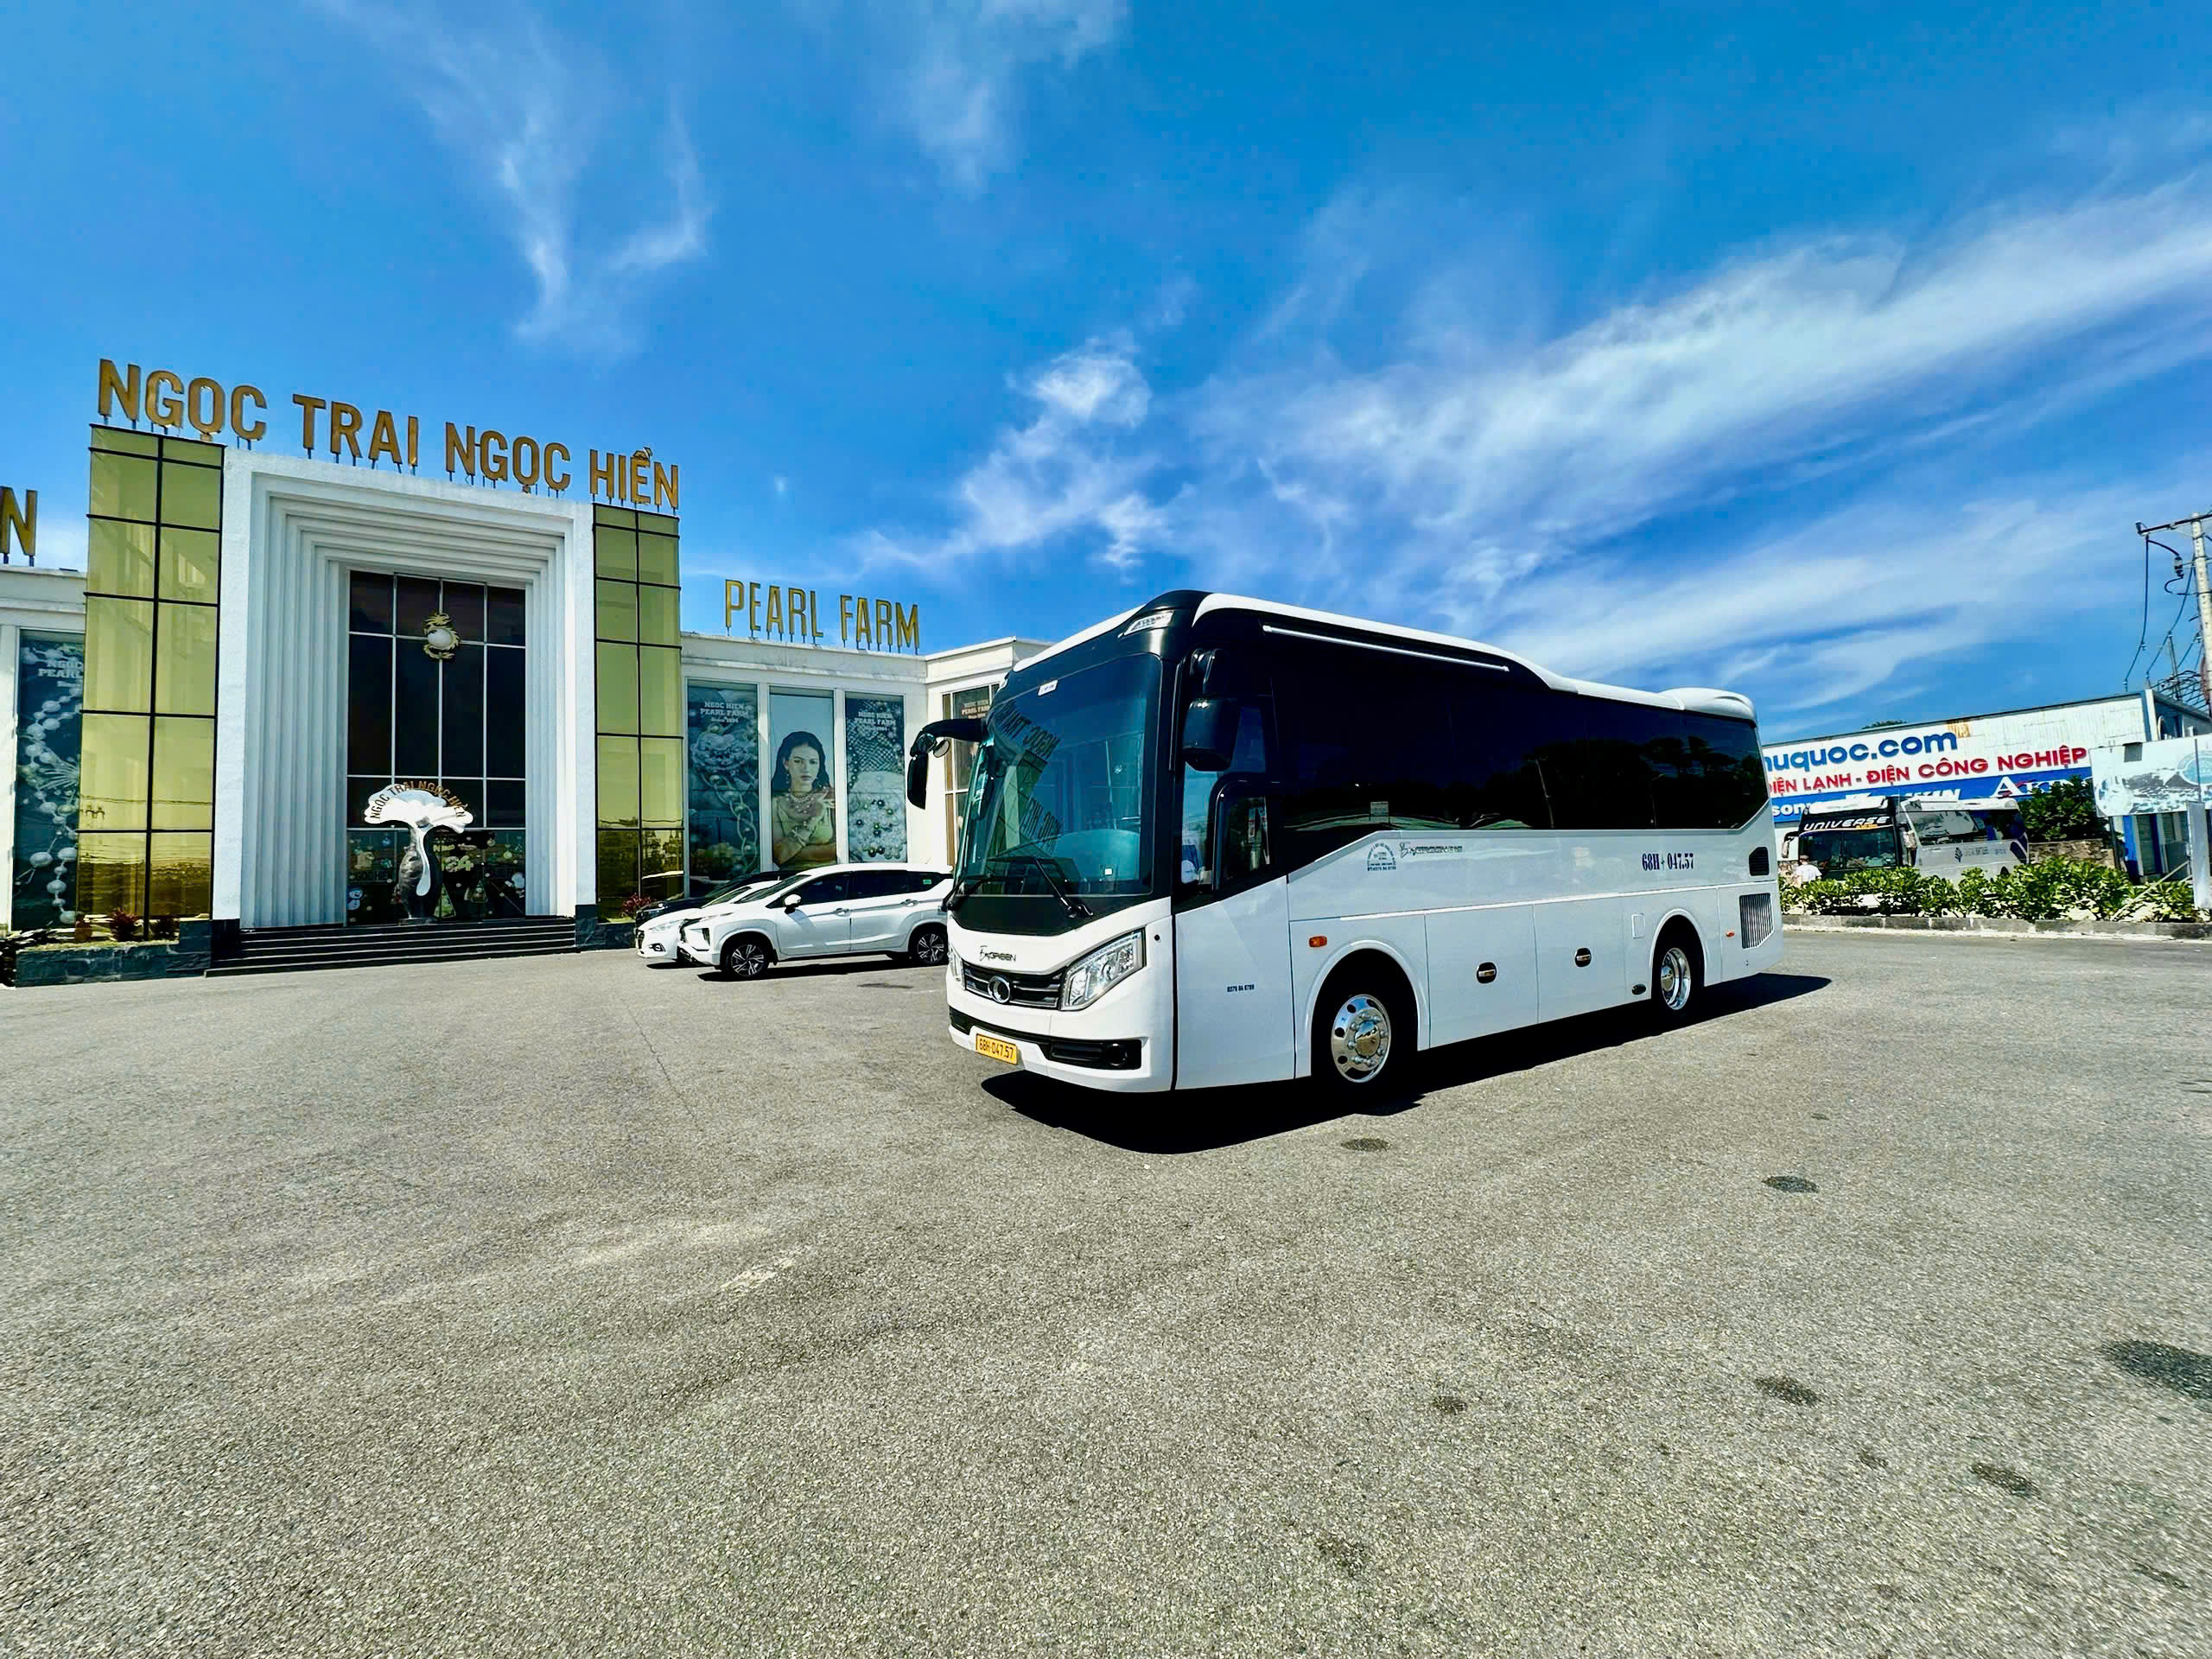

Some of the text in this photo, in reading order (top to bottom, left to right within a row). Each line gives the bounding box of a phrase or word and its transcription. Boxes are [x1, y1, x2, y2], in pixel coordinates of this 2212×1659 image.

[98, 357, 268, 442] NGỌC
[292, 393, 420, 467] TRAI
[445, 421, 571, 493] NGỌC
[725, 579, 920, 650] PEARL FARM
[1803, 772, 1853, 793] LẠNH
[1866, 764, 1910, 786] ĐIỆN
[1917, 757, 1989, 779] CÔNG
[1997, 745, 2088, 772] NGHIỆP
[1803, 815, 1891, 831] UNIVERSE
[1642, 853, 1660, 871] 68H
[1667, 852, 1694, 870] 047.57
